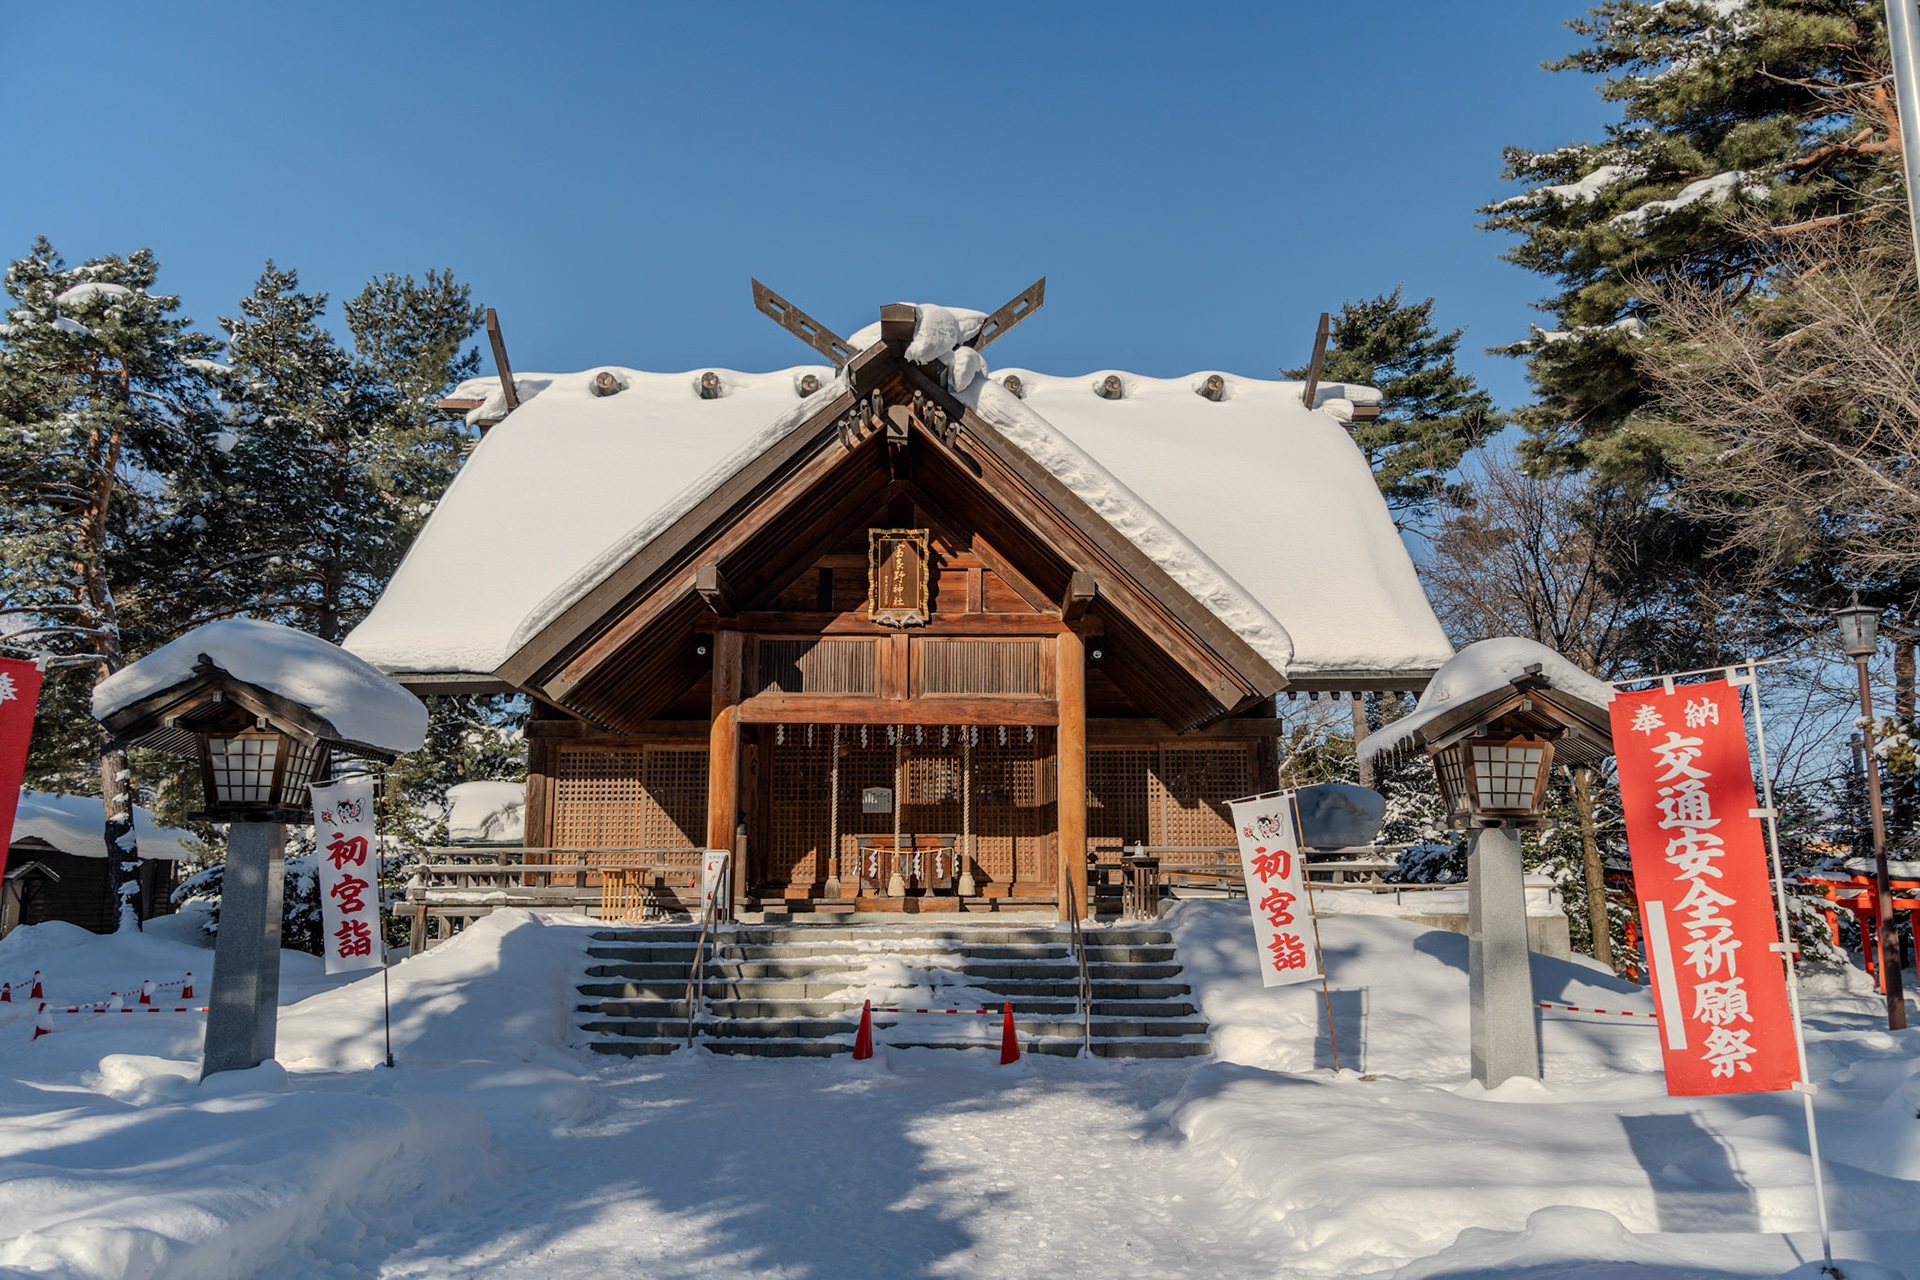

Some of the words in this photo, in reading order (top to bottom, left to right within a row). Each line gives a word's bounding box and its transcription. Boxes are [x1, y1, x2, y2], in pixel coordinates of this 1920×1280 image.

[1631, 697, 1720, 737] 奉納
[326, 832, 371, 959] 初宮詣
[1250, 846, 1307, 972] 初宮詣
[1650, 731, 1758, 1079] 交通安全祈願祭
